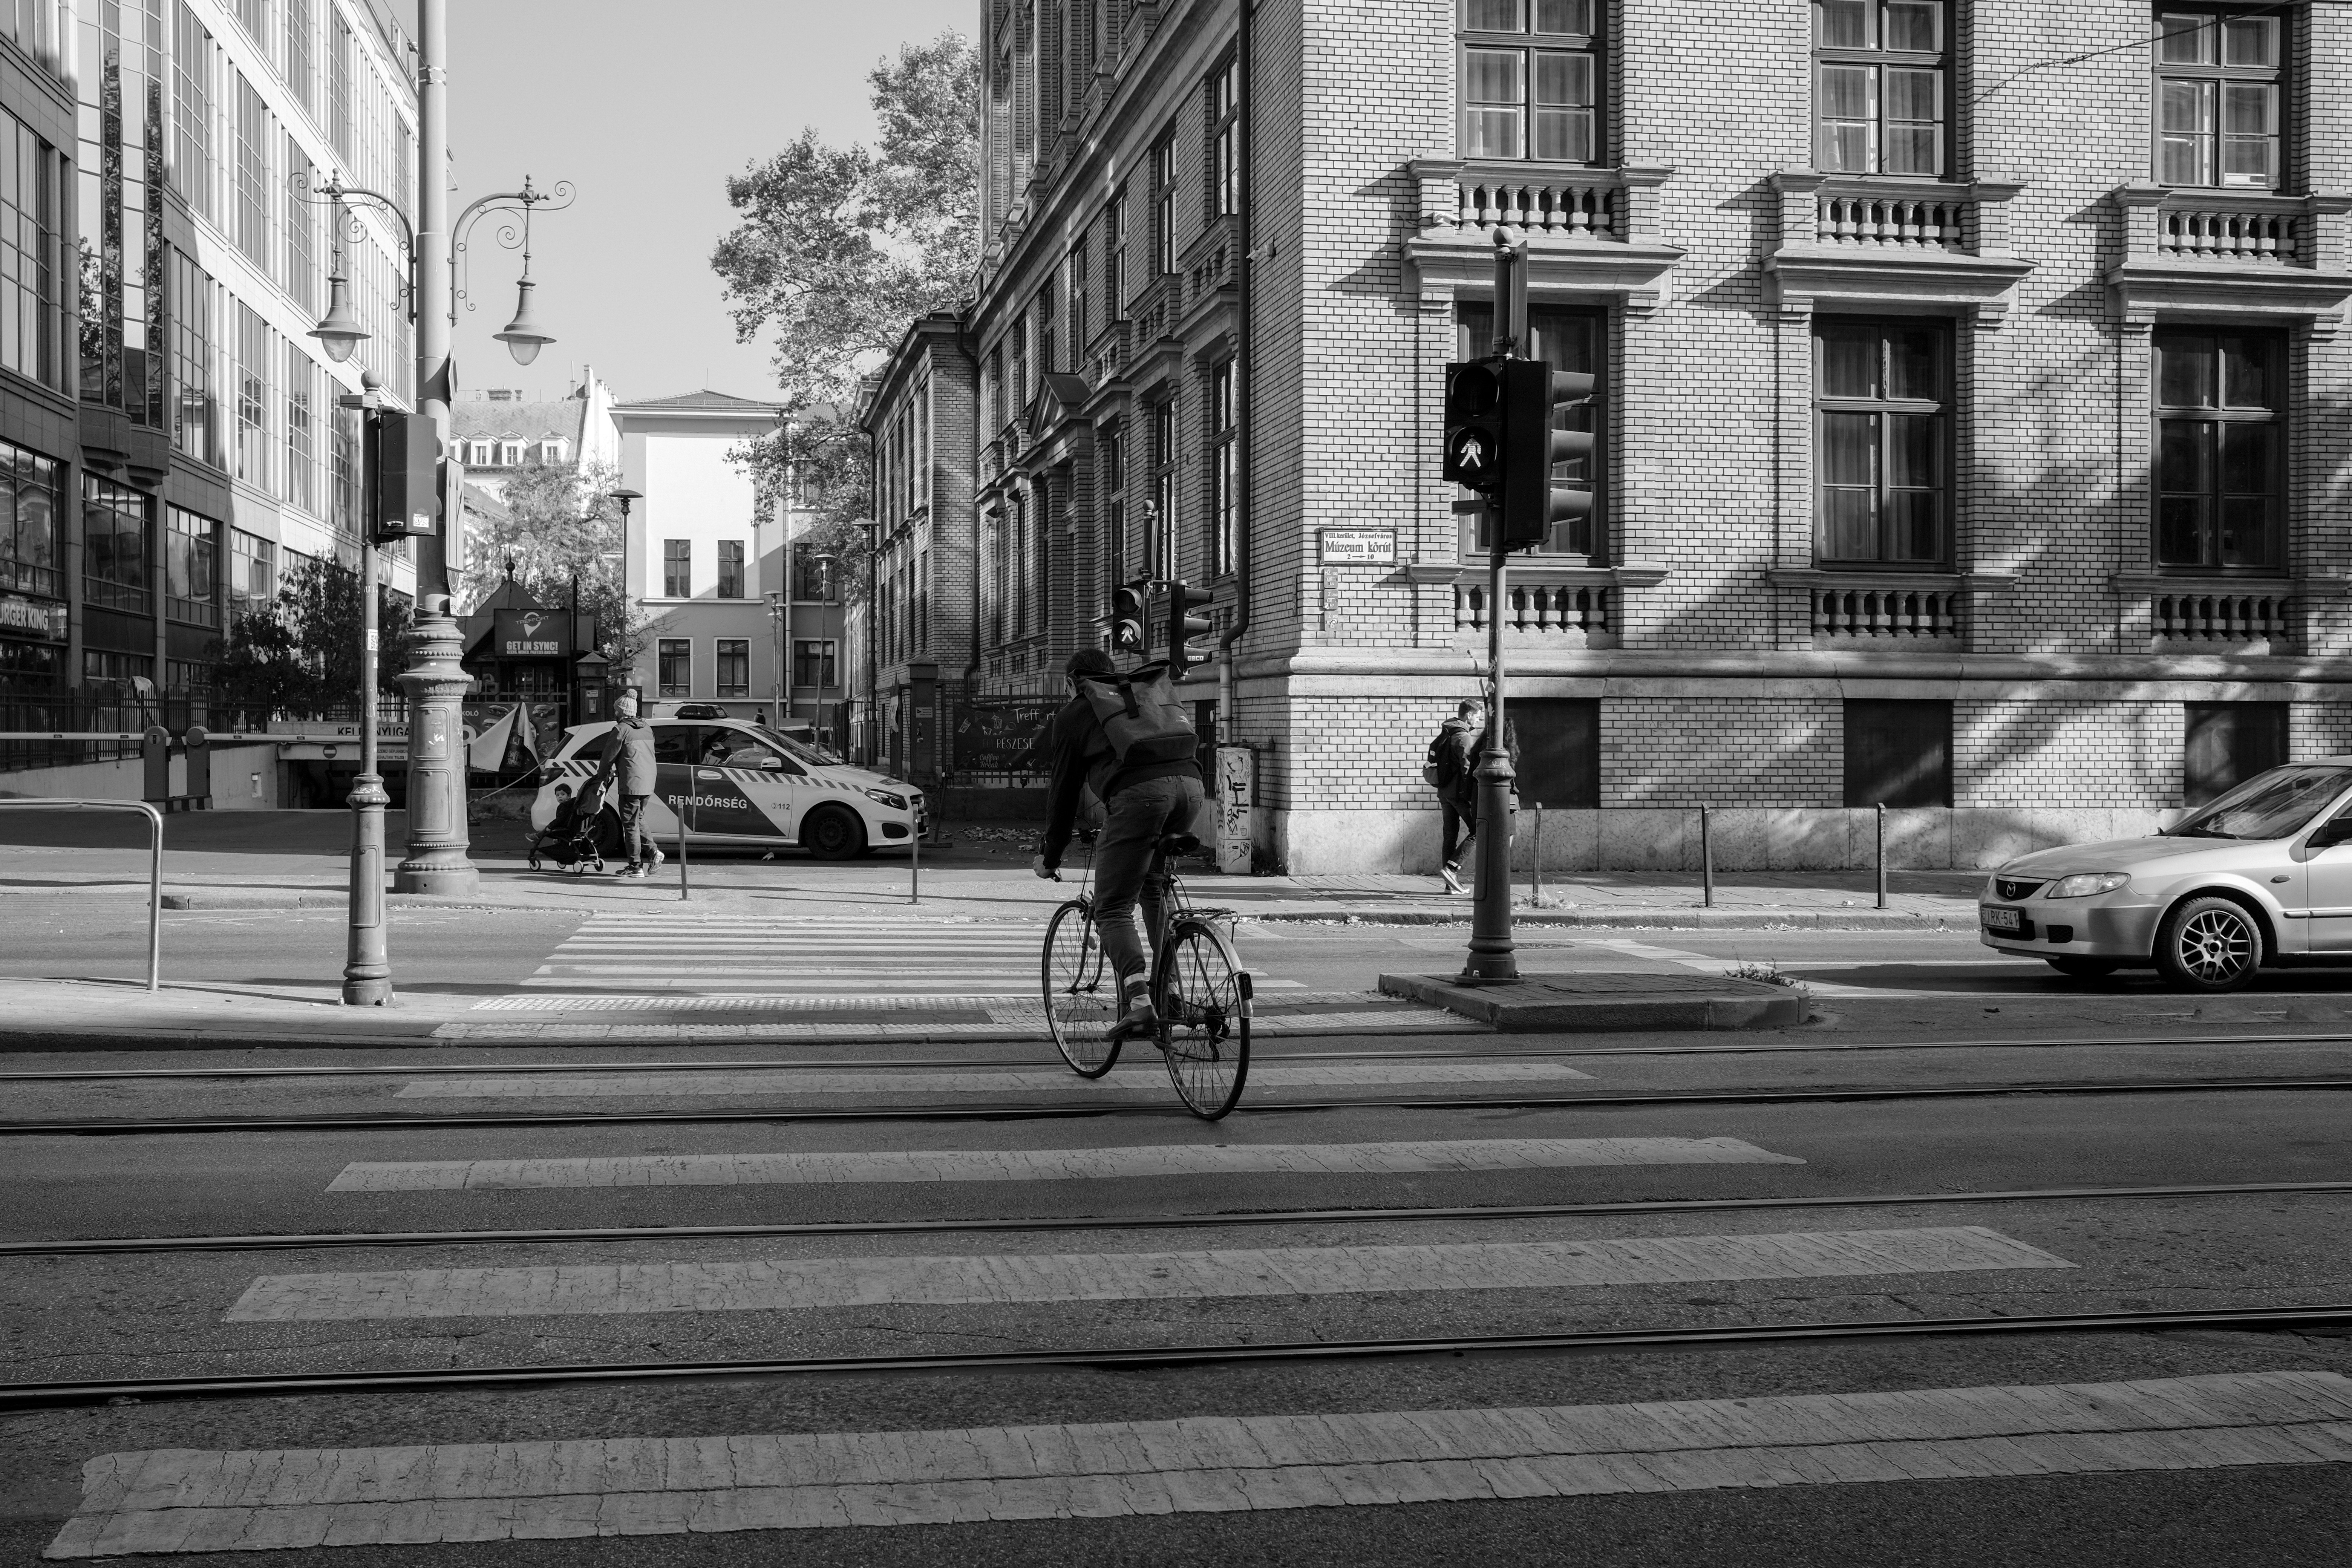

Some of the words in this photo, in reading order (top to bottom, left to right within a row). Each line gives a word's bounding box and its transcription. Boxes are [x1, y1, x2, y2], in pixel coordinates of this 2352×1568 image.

[1325, 541, 1364, 552] Múzeum
[0, 602, 26, 627] URGER
[28, 607, 49, 631] KING
[516, 616, 549, 625] TREFFORT
[507, 641, 522, 650] GET
[523, 642, 532, 650] IN
[533, 642, 558, 650] SYNC!
[997, 737, 1036, 749] RÉSZESE
[980, 753, 999, 763] Coffee
[668, 795, 747, 809] RENDŐRSÉG
